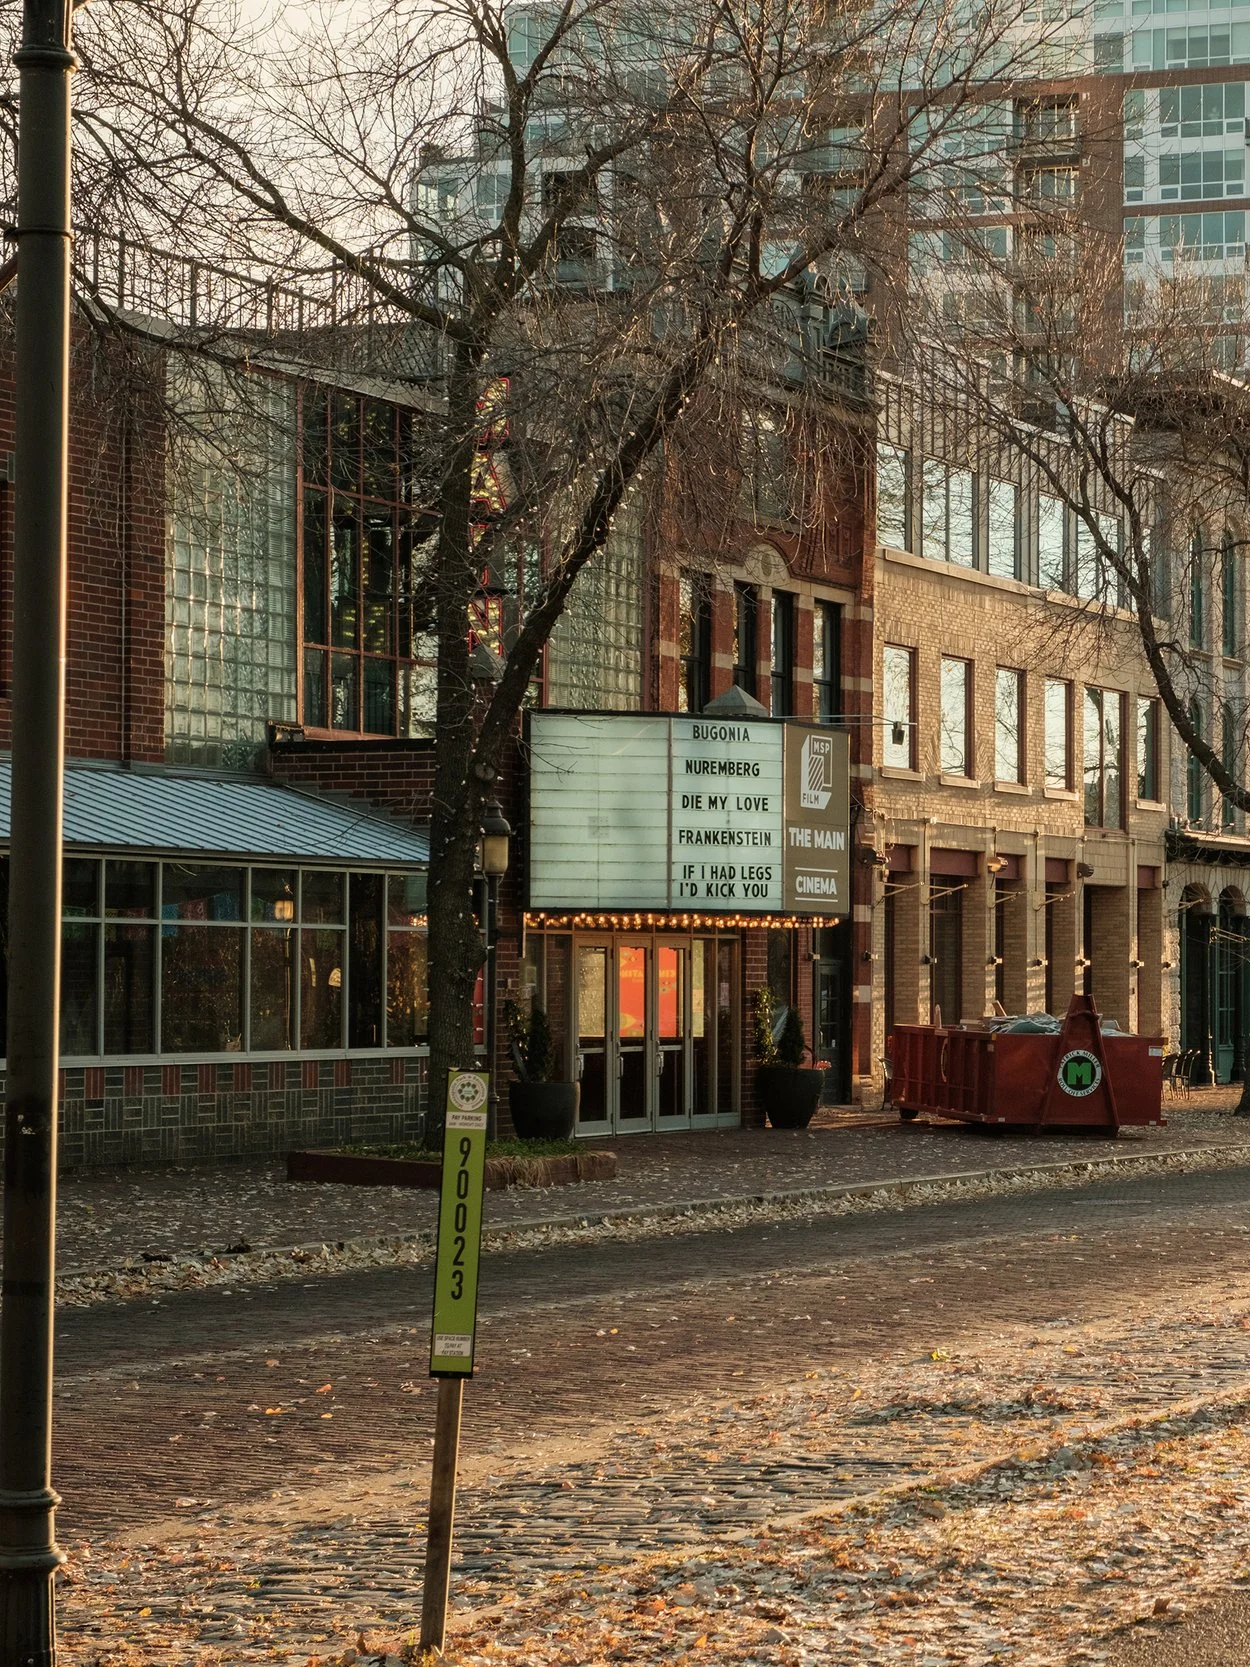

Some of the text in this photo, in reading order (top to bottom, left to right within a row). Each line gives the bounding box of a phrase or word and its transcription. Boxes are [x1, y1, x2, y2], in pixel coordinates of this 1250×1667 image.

[693, 725, 750, 741] BUGONIA
[813, 741, 830, 754] MSP
[686, 760, 760, 777] NUREMBERG
[682, 794, 769, 811] DIE MY LOVE
[802, 793, 820, 805] FILM
[679, 829, 771, 846] FRANKENSTEIN
[788, 827, 845, 850] THE MAIN
[683, 864, 772, 881] IF I HAD LEGS
[680, 882, 768, 897] I'D KICK YOU
[795, 875, 837, 895] CINEMA
[1068, 1063, 1091, 1084] M
[451, 1137, 471, 1300] 90023
